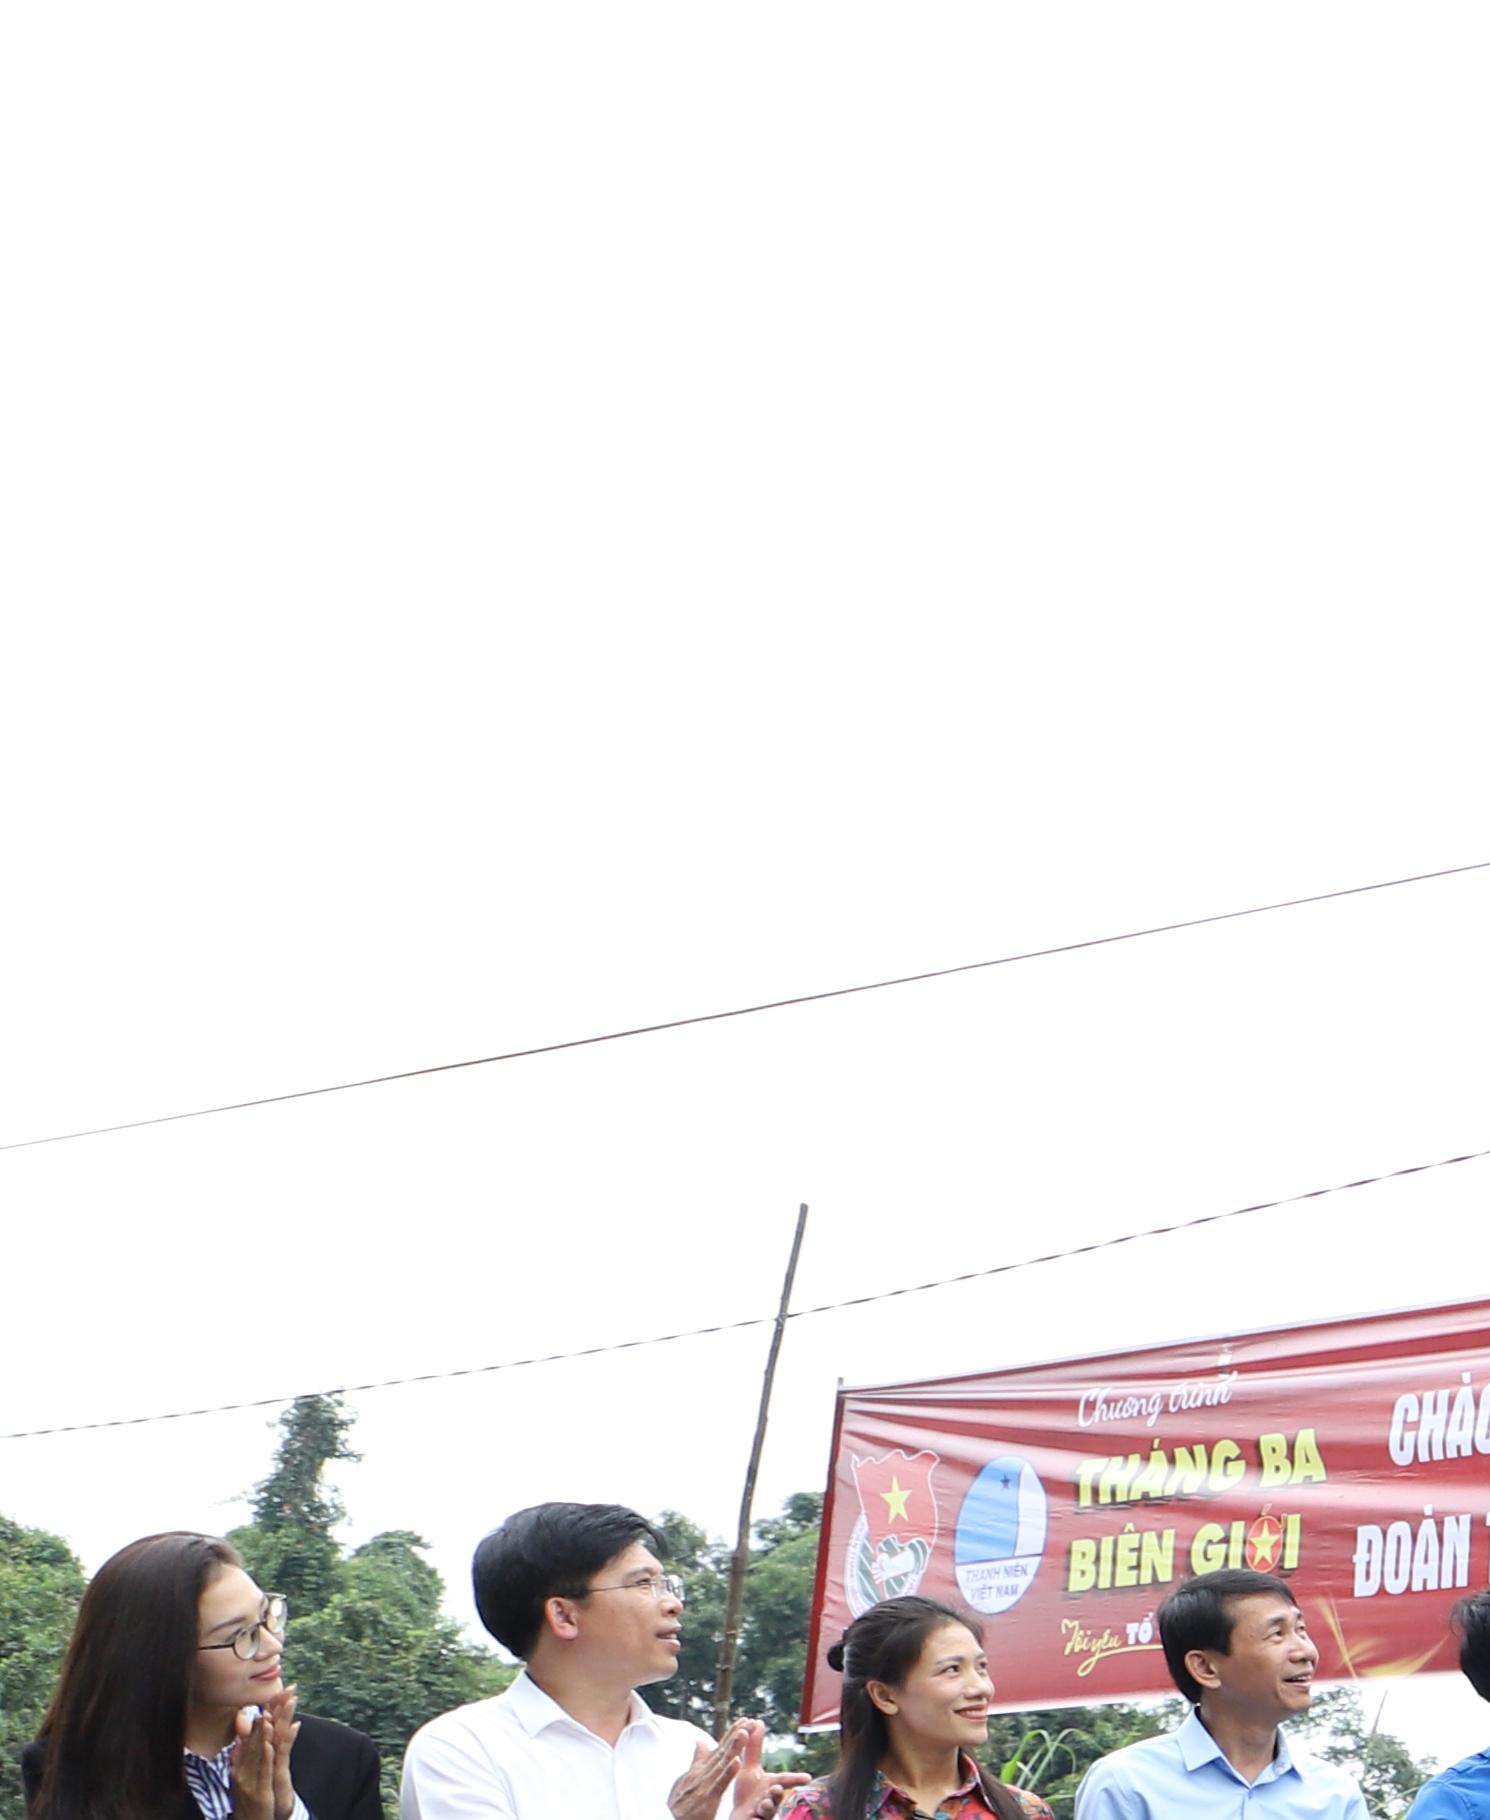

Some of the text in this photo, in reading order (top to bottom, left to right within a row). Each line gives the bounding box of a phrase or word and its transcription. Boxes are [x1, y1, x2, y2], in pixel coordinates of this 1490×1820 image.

[1075, 1428, 1328, 1508] THÁNG BA
[1068, 1521, 1177, 1593] BIÊN
[1352, 1504, 1472, 1598] ĐOÀN
[996, 1583, 1019, 1599] NAM
